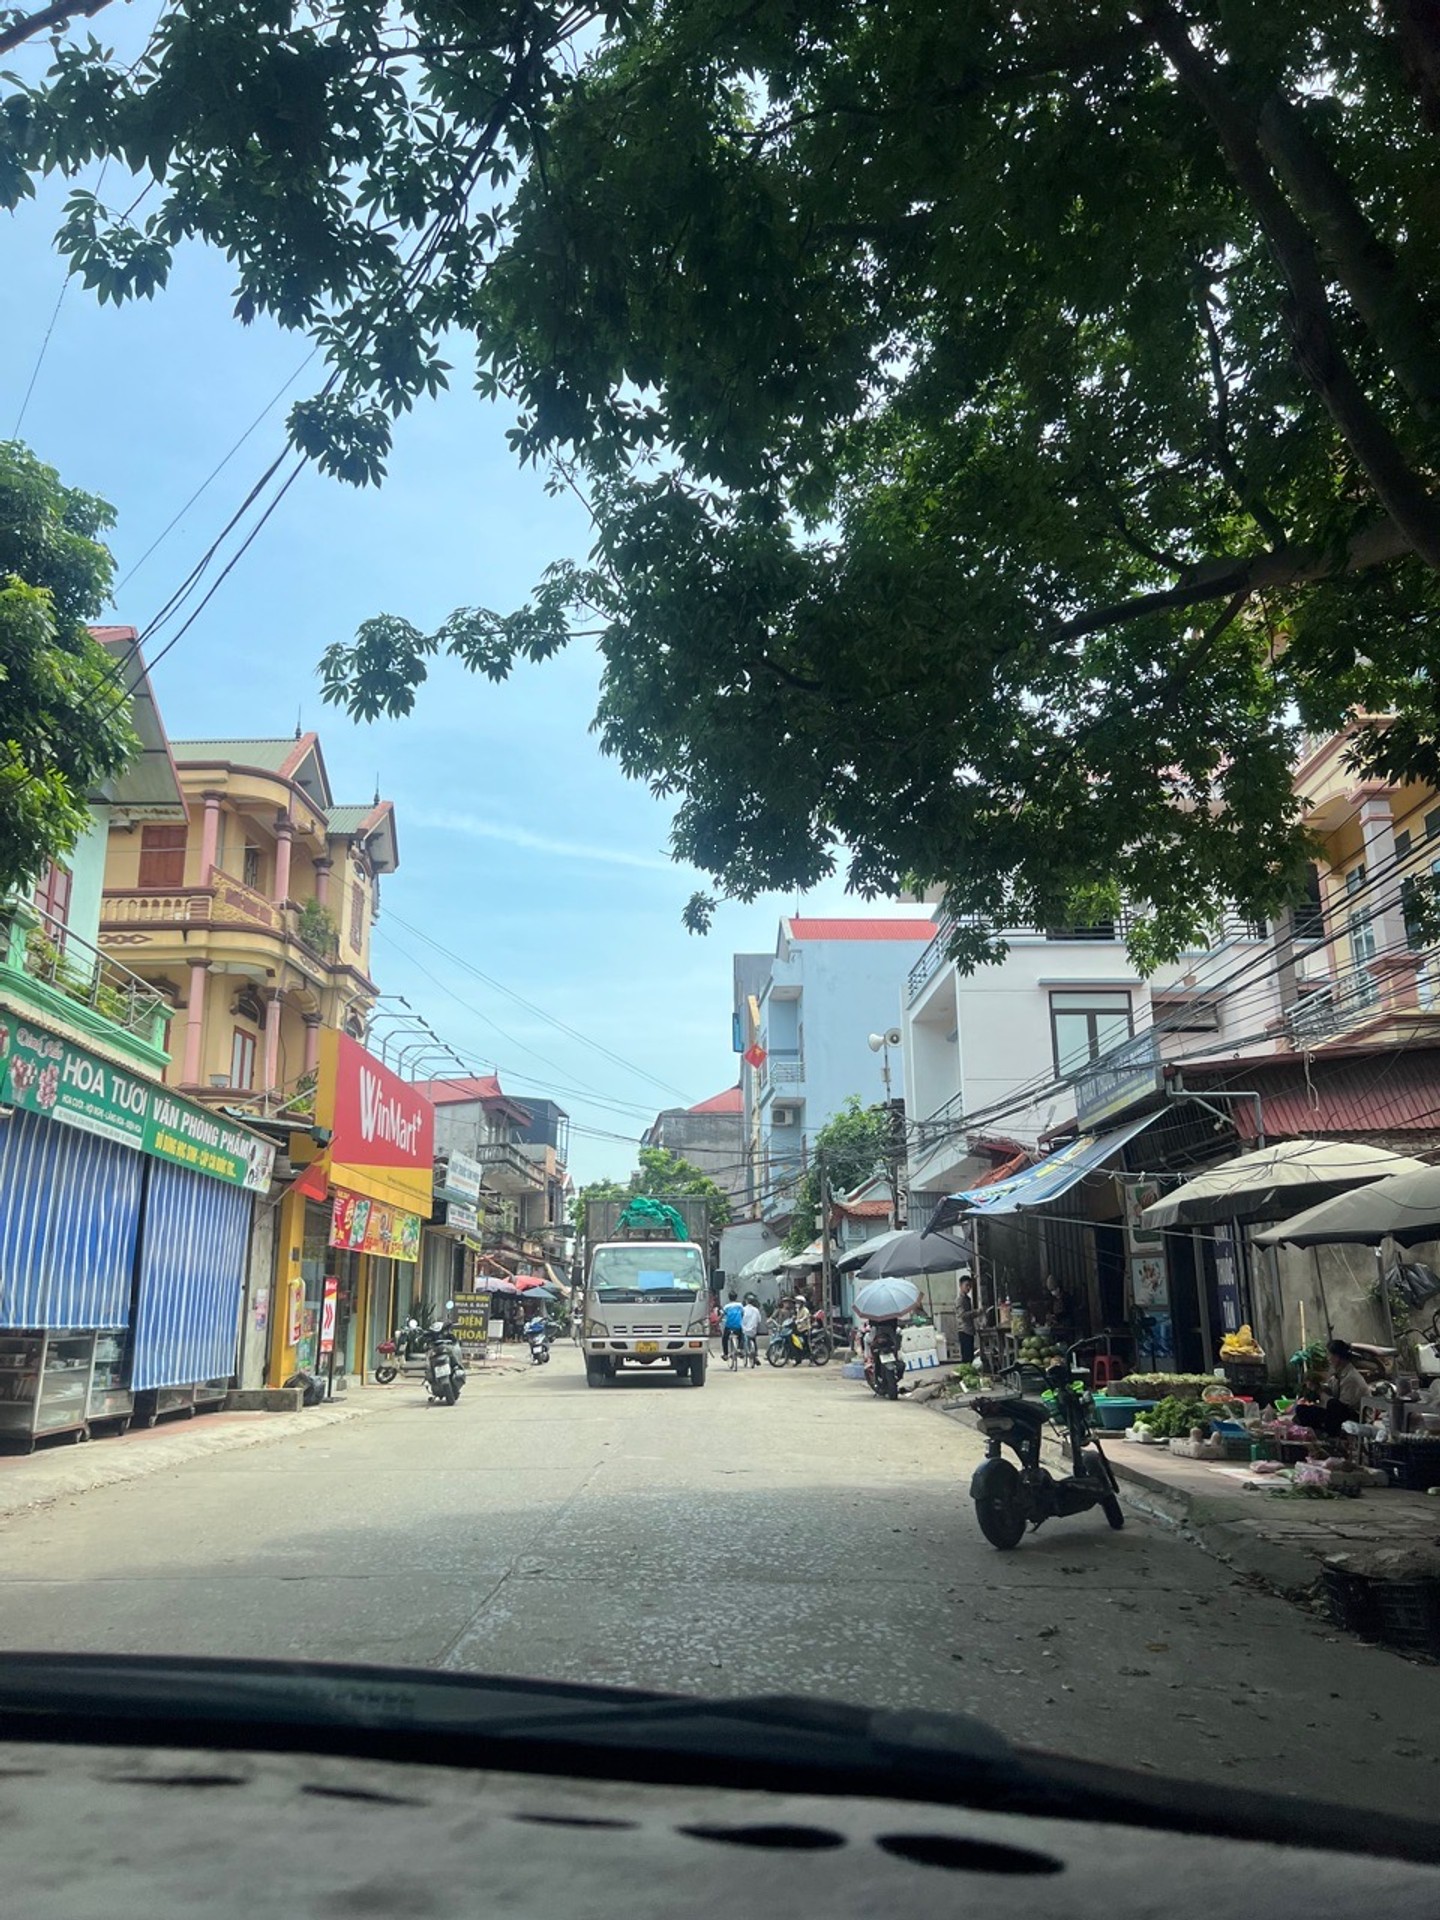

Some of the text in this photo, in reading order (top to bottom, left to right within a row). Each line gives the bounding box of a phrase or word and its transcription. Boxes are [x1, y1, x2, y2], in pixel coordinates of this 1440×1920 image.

[62, 1053, 148, 1116] HOA TƯƠI
[153, 1097, 180, 1129] VĂN
[180, 1112, 219, 1147] PHÒNG
[219, 1129, 252, 1159] PHẨM
[452, 1329, 486, 1342] THOẠI
[457, 1314, 483, 1328] ĐIỆN
